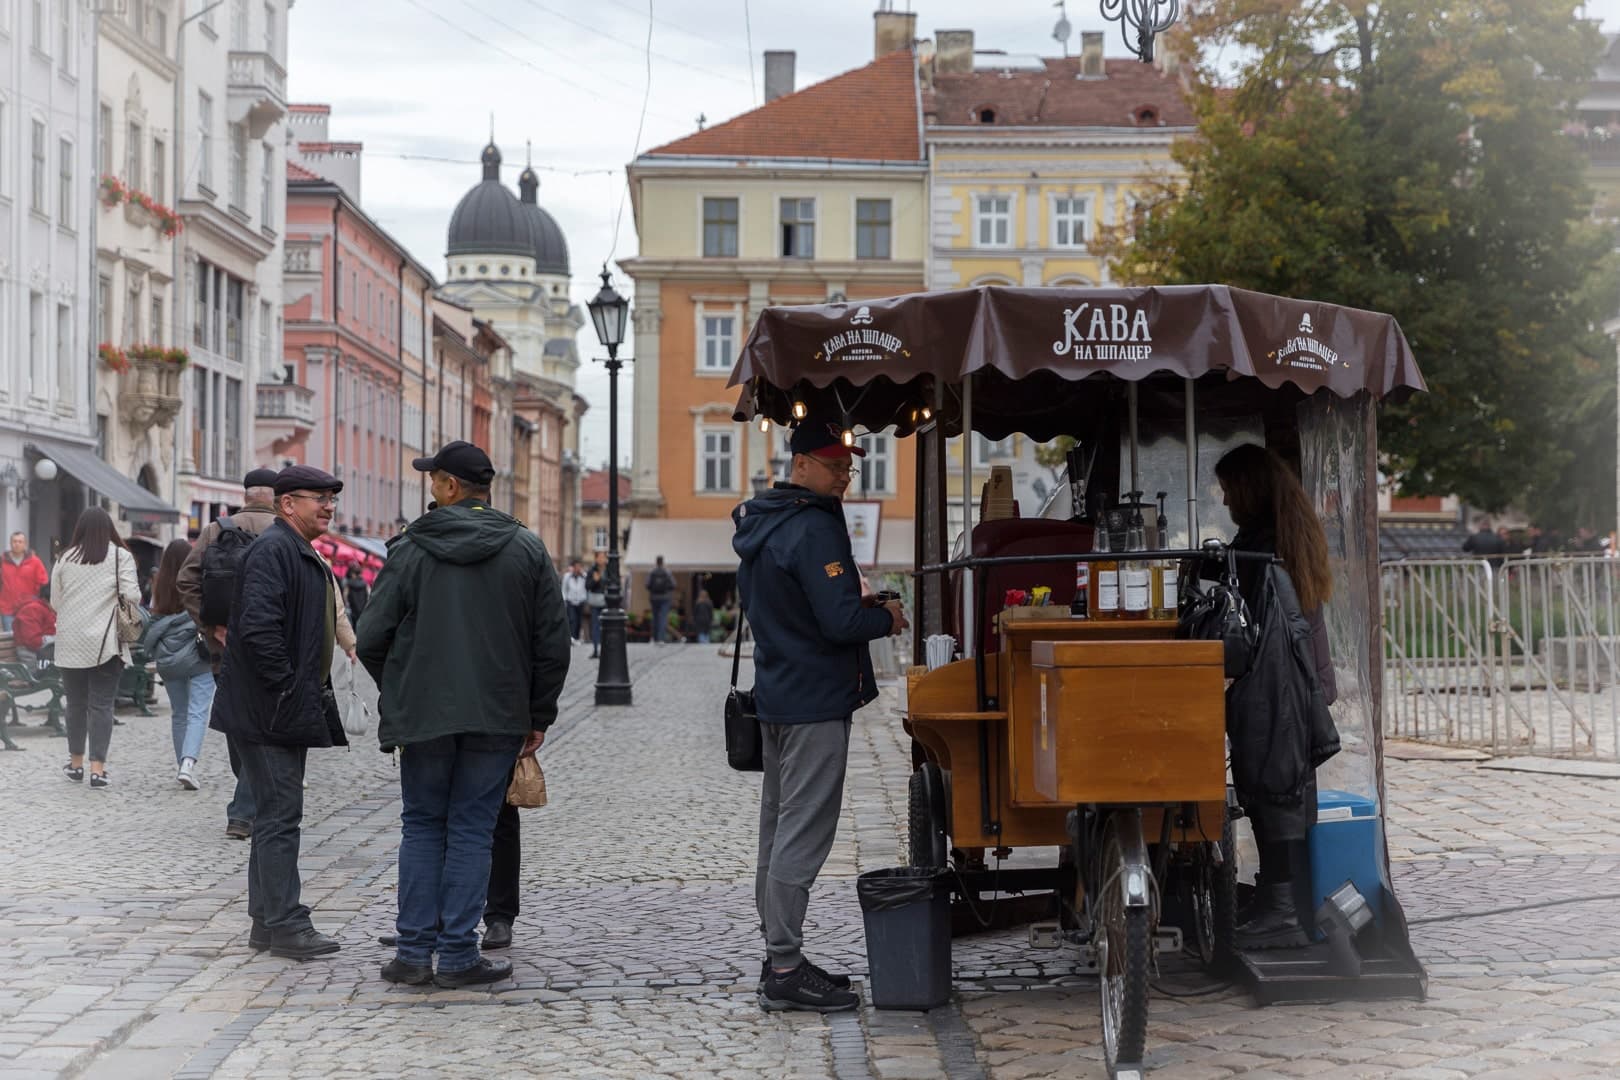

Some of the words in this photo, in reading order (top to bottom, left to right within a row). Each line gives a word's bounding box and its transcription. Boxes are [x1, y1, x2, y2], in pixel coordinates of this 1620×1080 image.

[1053, 302, 1152, 355] КАВА
[823, 334, 847, 362] КАВА
[845, 329, 861, 345] НА
[862, 328, 902, 353] ШПАЦЕР
[1073, 345, 1093, 360] НА
[1095, 345, 1152, 363] ШПАЦЕР
[1295, 336, 1307, 351] НА
[1307, 337, 1338, 365] ШПАЦЕР
